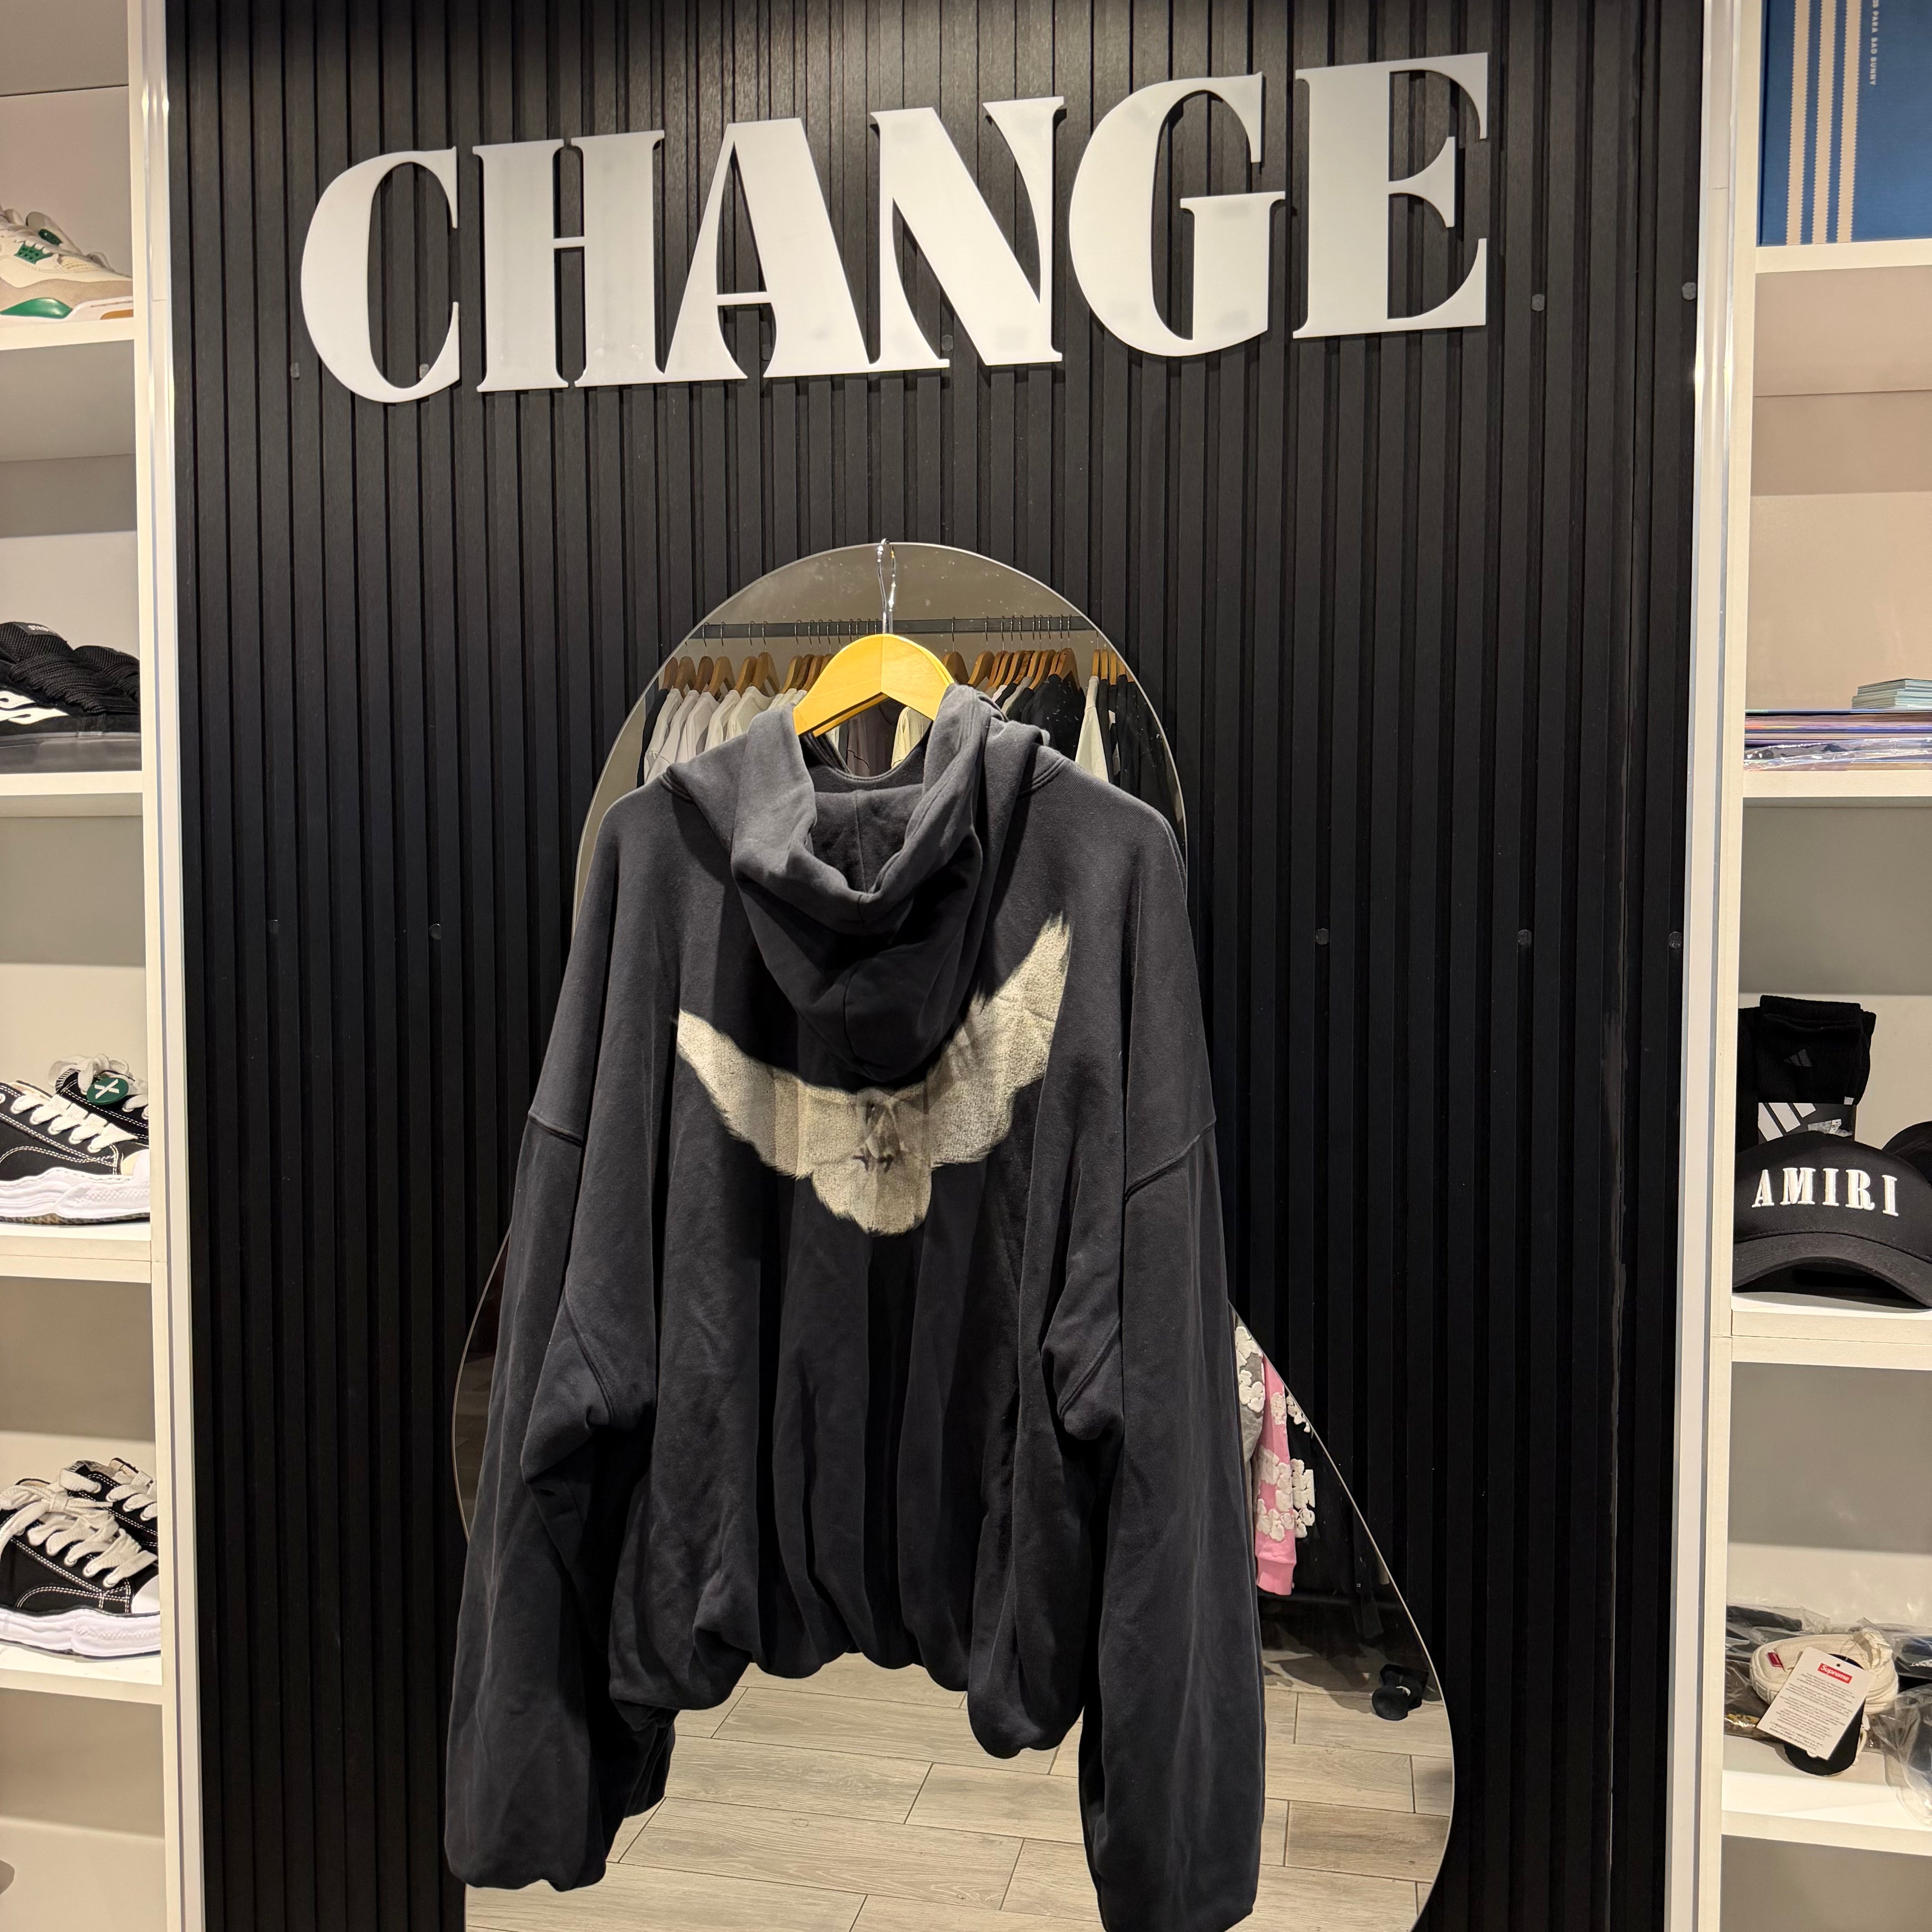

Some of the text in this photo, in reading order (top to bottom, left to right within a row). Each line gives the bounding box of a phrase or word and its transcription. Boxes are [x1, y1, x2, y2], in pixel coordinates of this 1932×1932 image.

[300, 52, 1488, 403] CHANGE
[1751, 1167, 1899, 1217] AMIRI
[1820, 1665, 1850, 1681] Supreme
